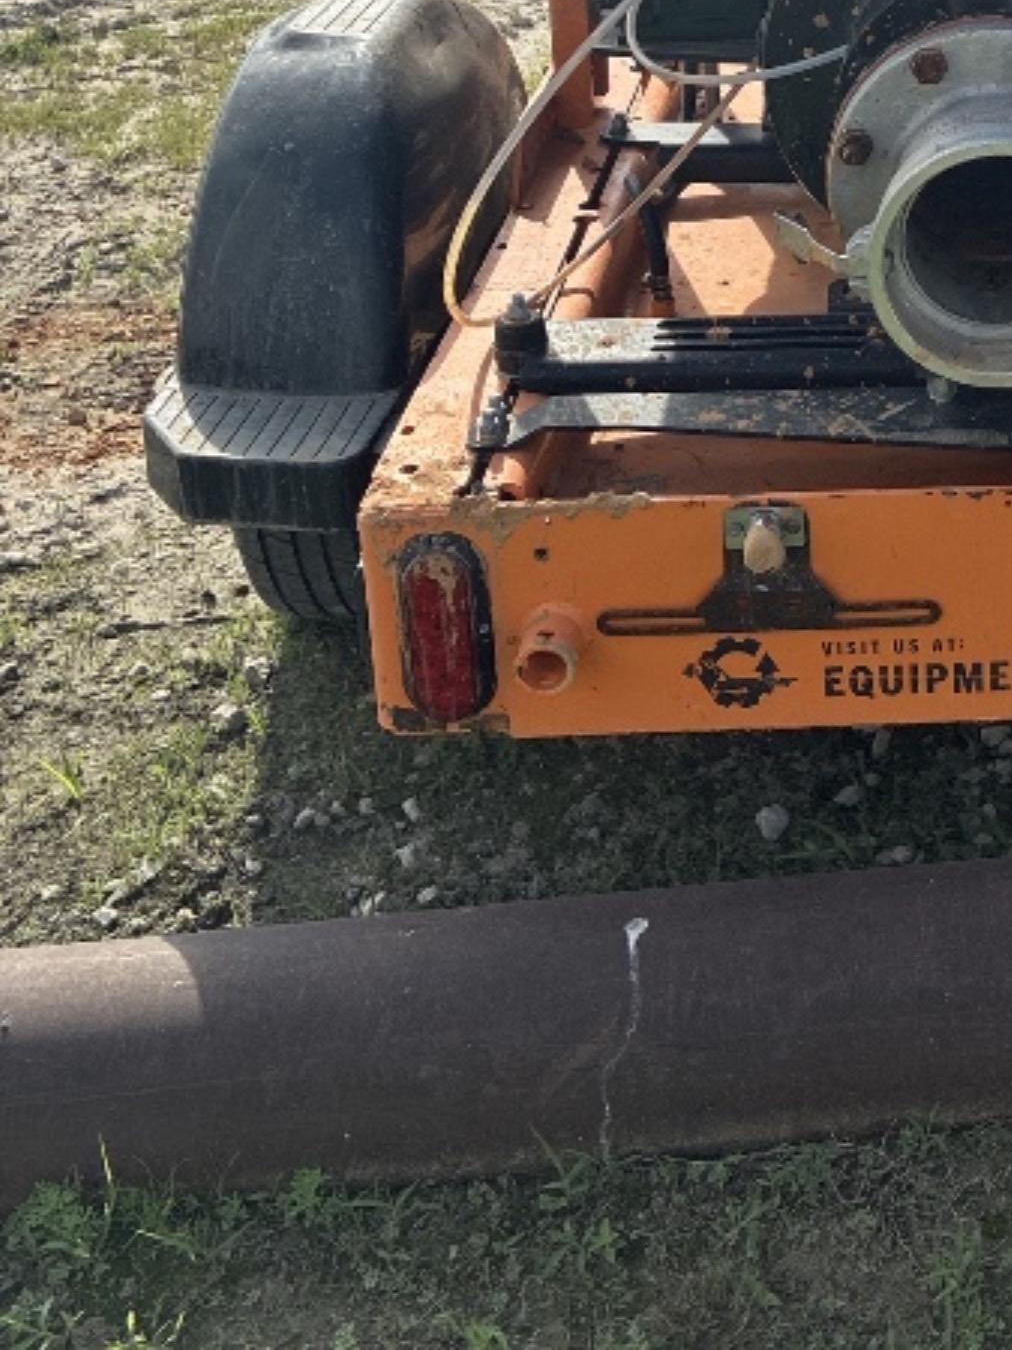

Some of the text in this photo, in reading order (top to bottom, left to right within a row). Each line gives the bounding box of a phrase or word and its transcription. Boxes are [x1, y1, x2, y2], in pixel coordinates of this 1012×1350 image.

[821, 637, 964, 657] VISIT US AT:
